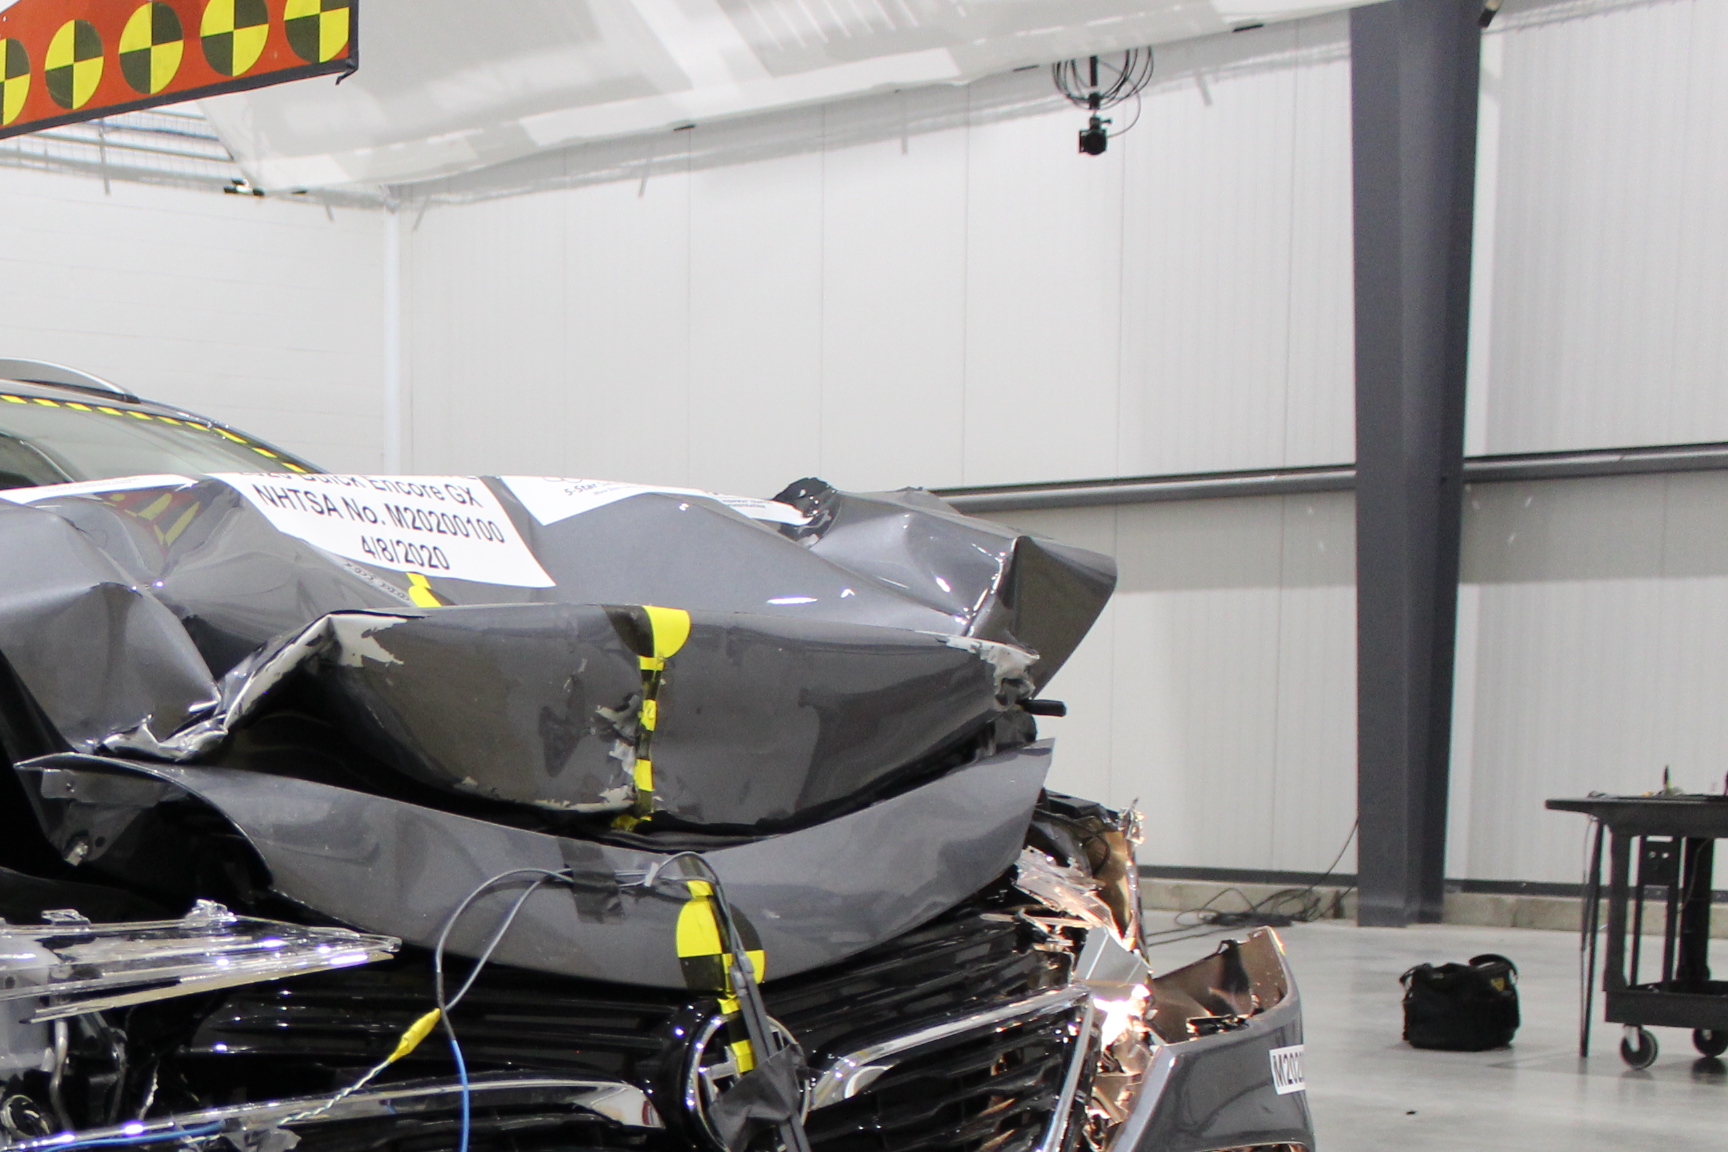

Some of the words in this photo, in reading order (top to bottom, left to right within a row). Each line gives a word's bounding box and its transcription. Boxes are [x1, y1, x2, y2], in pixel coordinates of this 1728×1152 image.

[445, 484, 483, 507] GX
[252, 484, 344, 519] NHTSA
[341, 496, 386, 525] No.
[384, 503, 505, 543] M20200100
[361, 535, 450, 570] 4/8/2020
